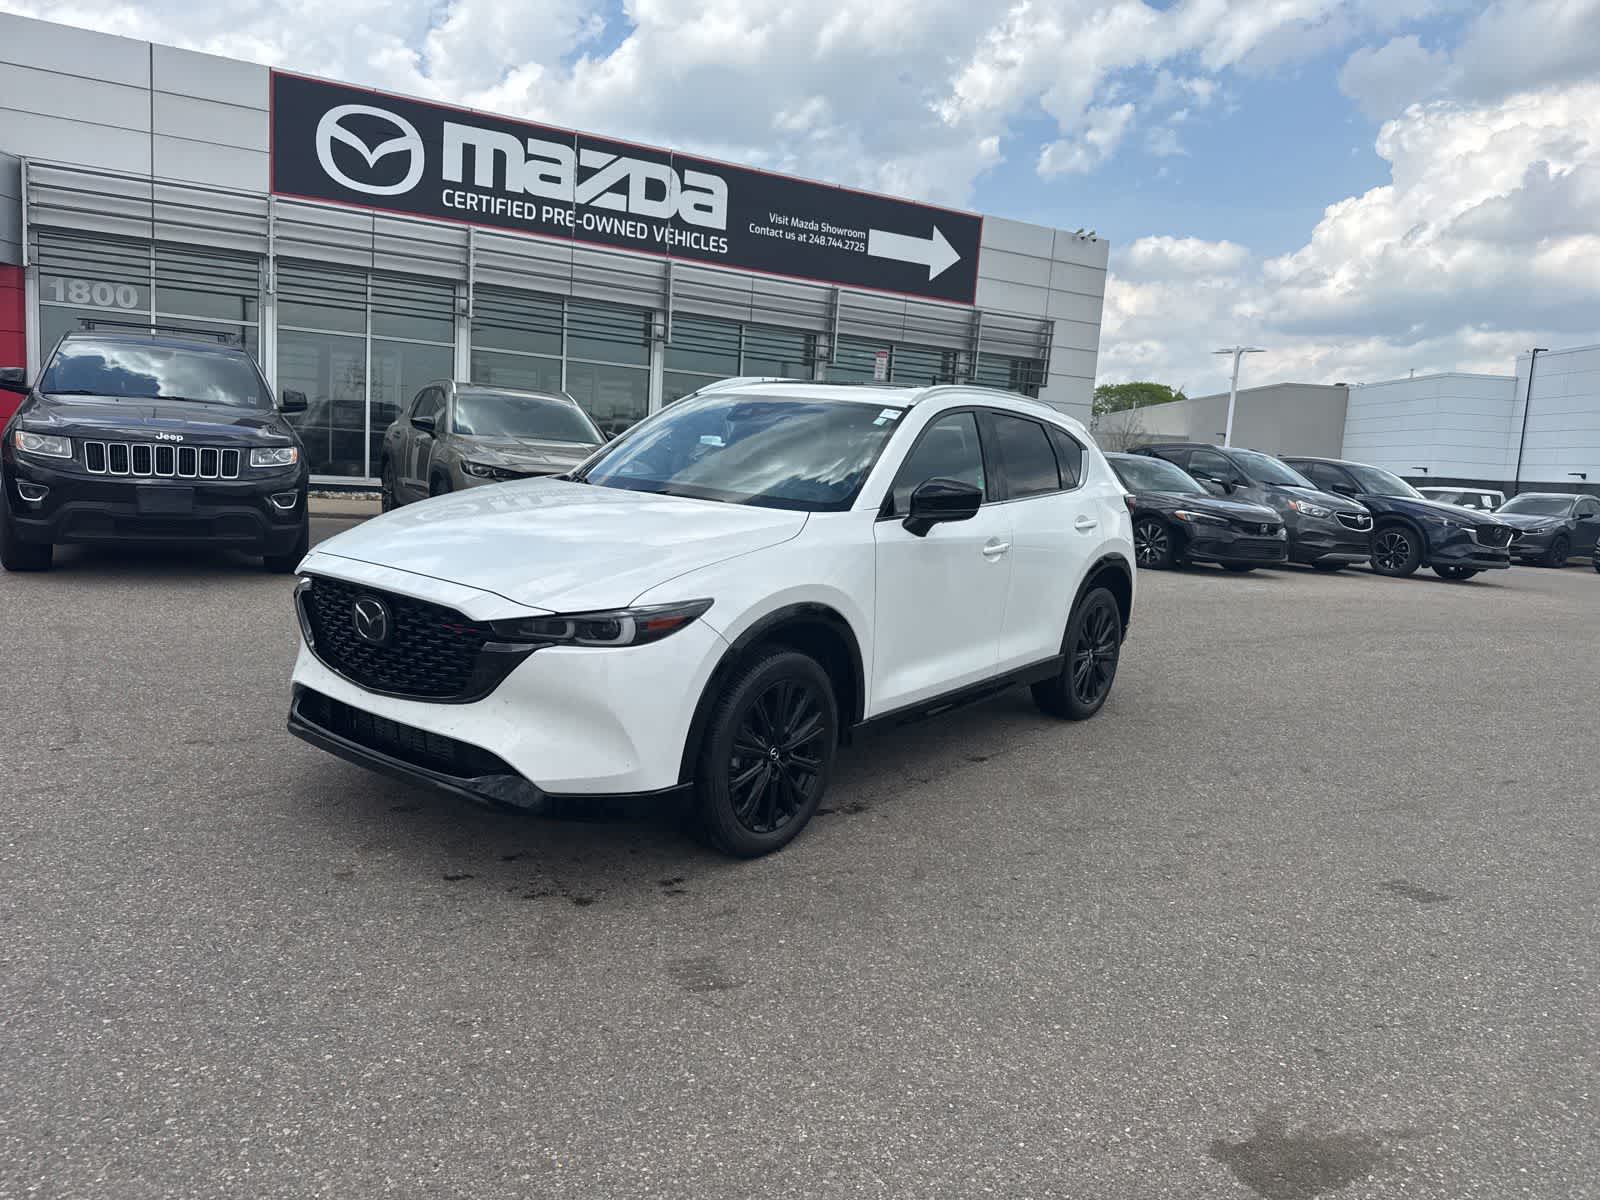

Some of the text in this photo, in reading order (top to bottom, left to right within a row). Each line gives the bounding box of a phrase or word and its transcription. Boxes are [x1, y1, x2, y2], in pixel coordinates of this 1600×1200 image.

[442, 189, 728, 254] CERTIFIED PRE-OWNED VEHICLES
[769, 211, 866, 239] Visit Mazda Showroom
[749, 223, 865, 253] Contact us at 248.744.2725
[47, 277, 138, 309] 1800
[155, 432, 184, 443] Jeep
